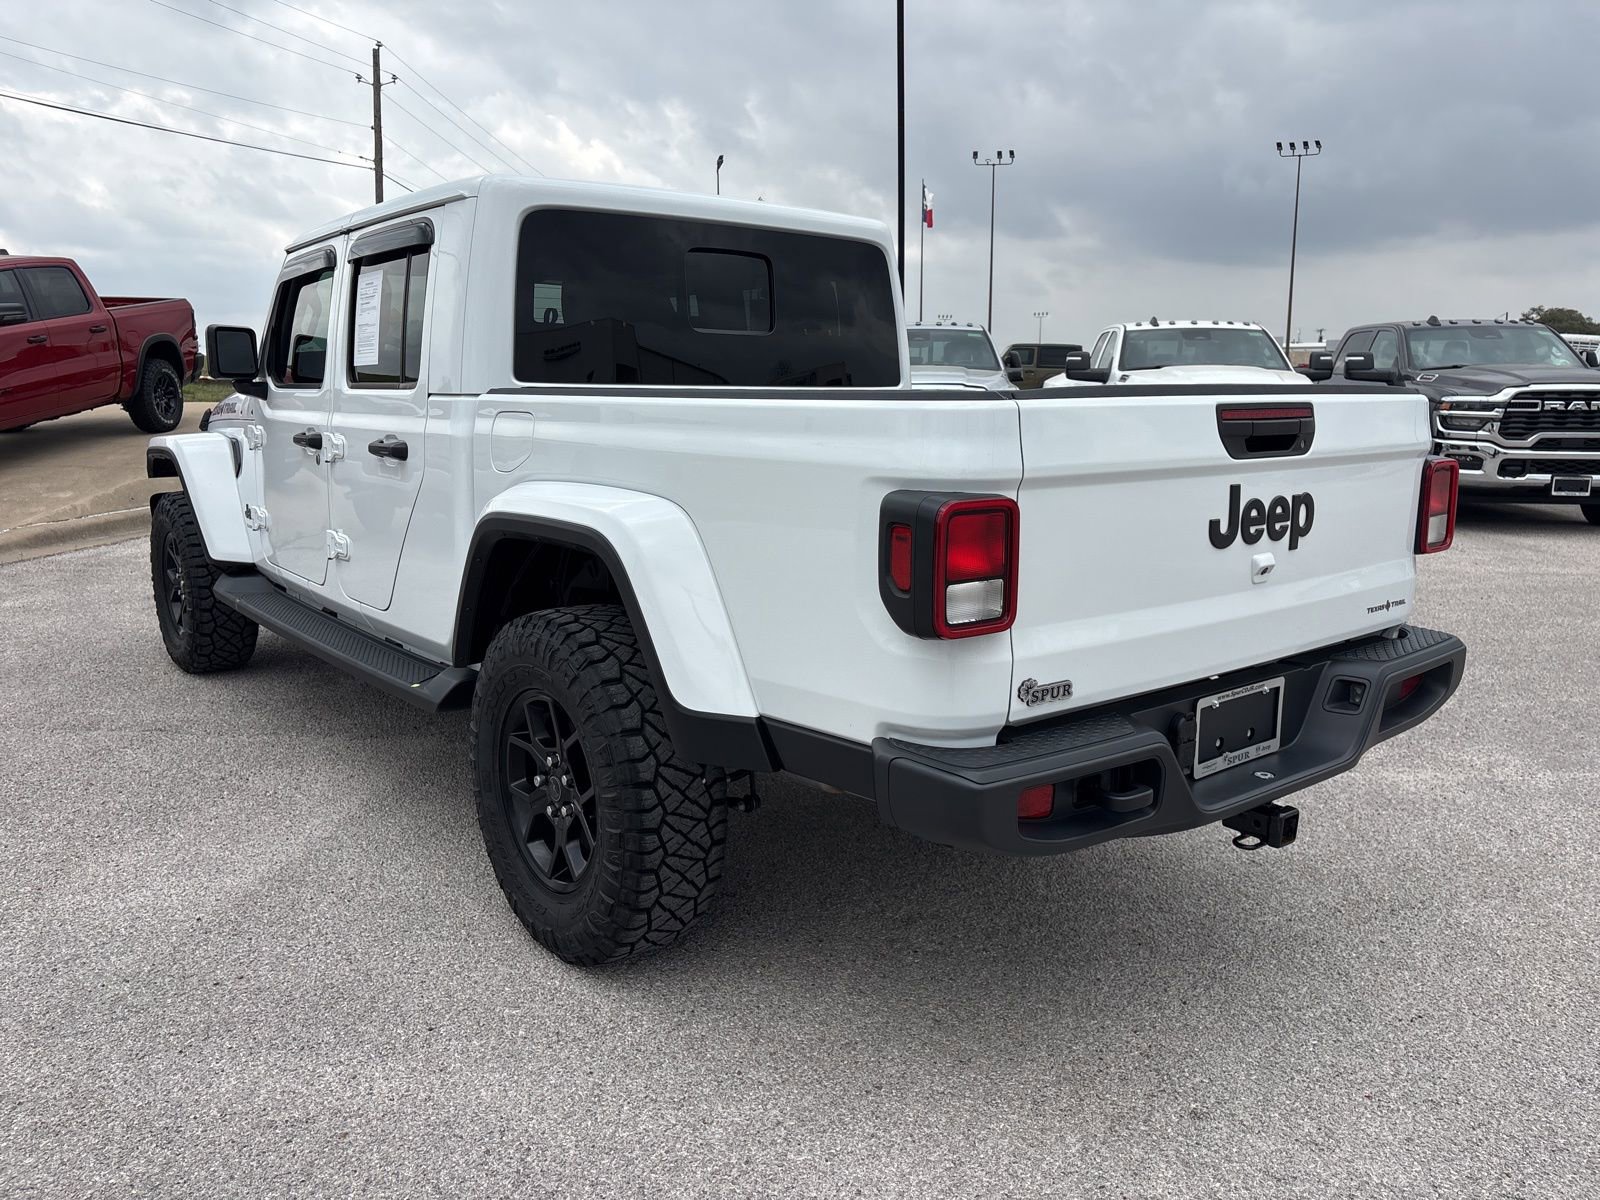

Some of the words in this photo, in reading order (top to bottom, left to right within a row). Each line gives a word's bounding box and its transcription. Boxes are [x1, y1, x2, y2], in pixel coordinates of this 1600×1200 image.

[1209, 484, 1315, 550] Jeep
[1367, 604, 1385, 614] TEXAS
[1391, 599, 1406, 607] TRAIL
[1031, 684, 1071, 703] SPUR
[1227, 751, 1250, 765] SPUR
